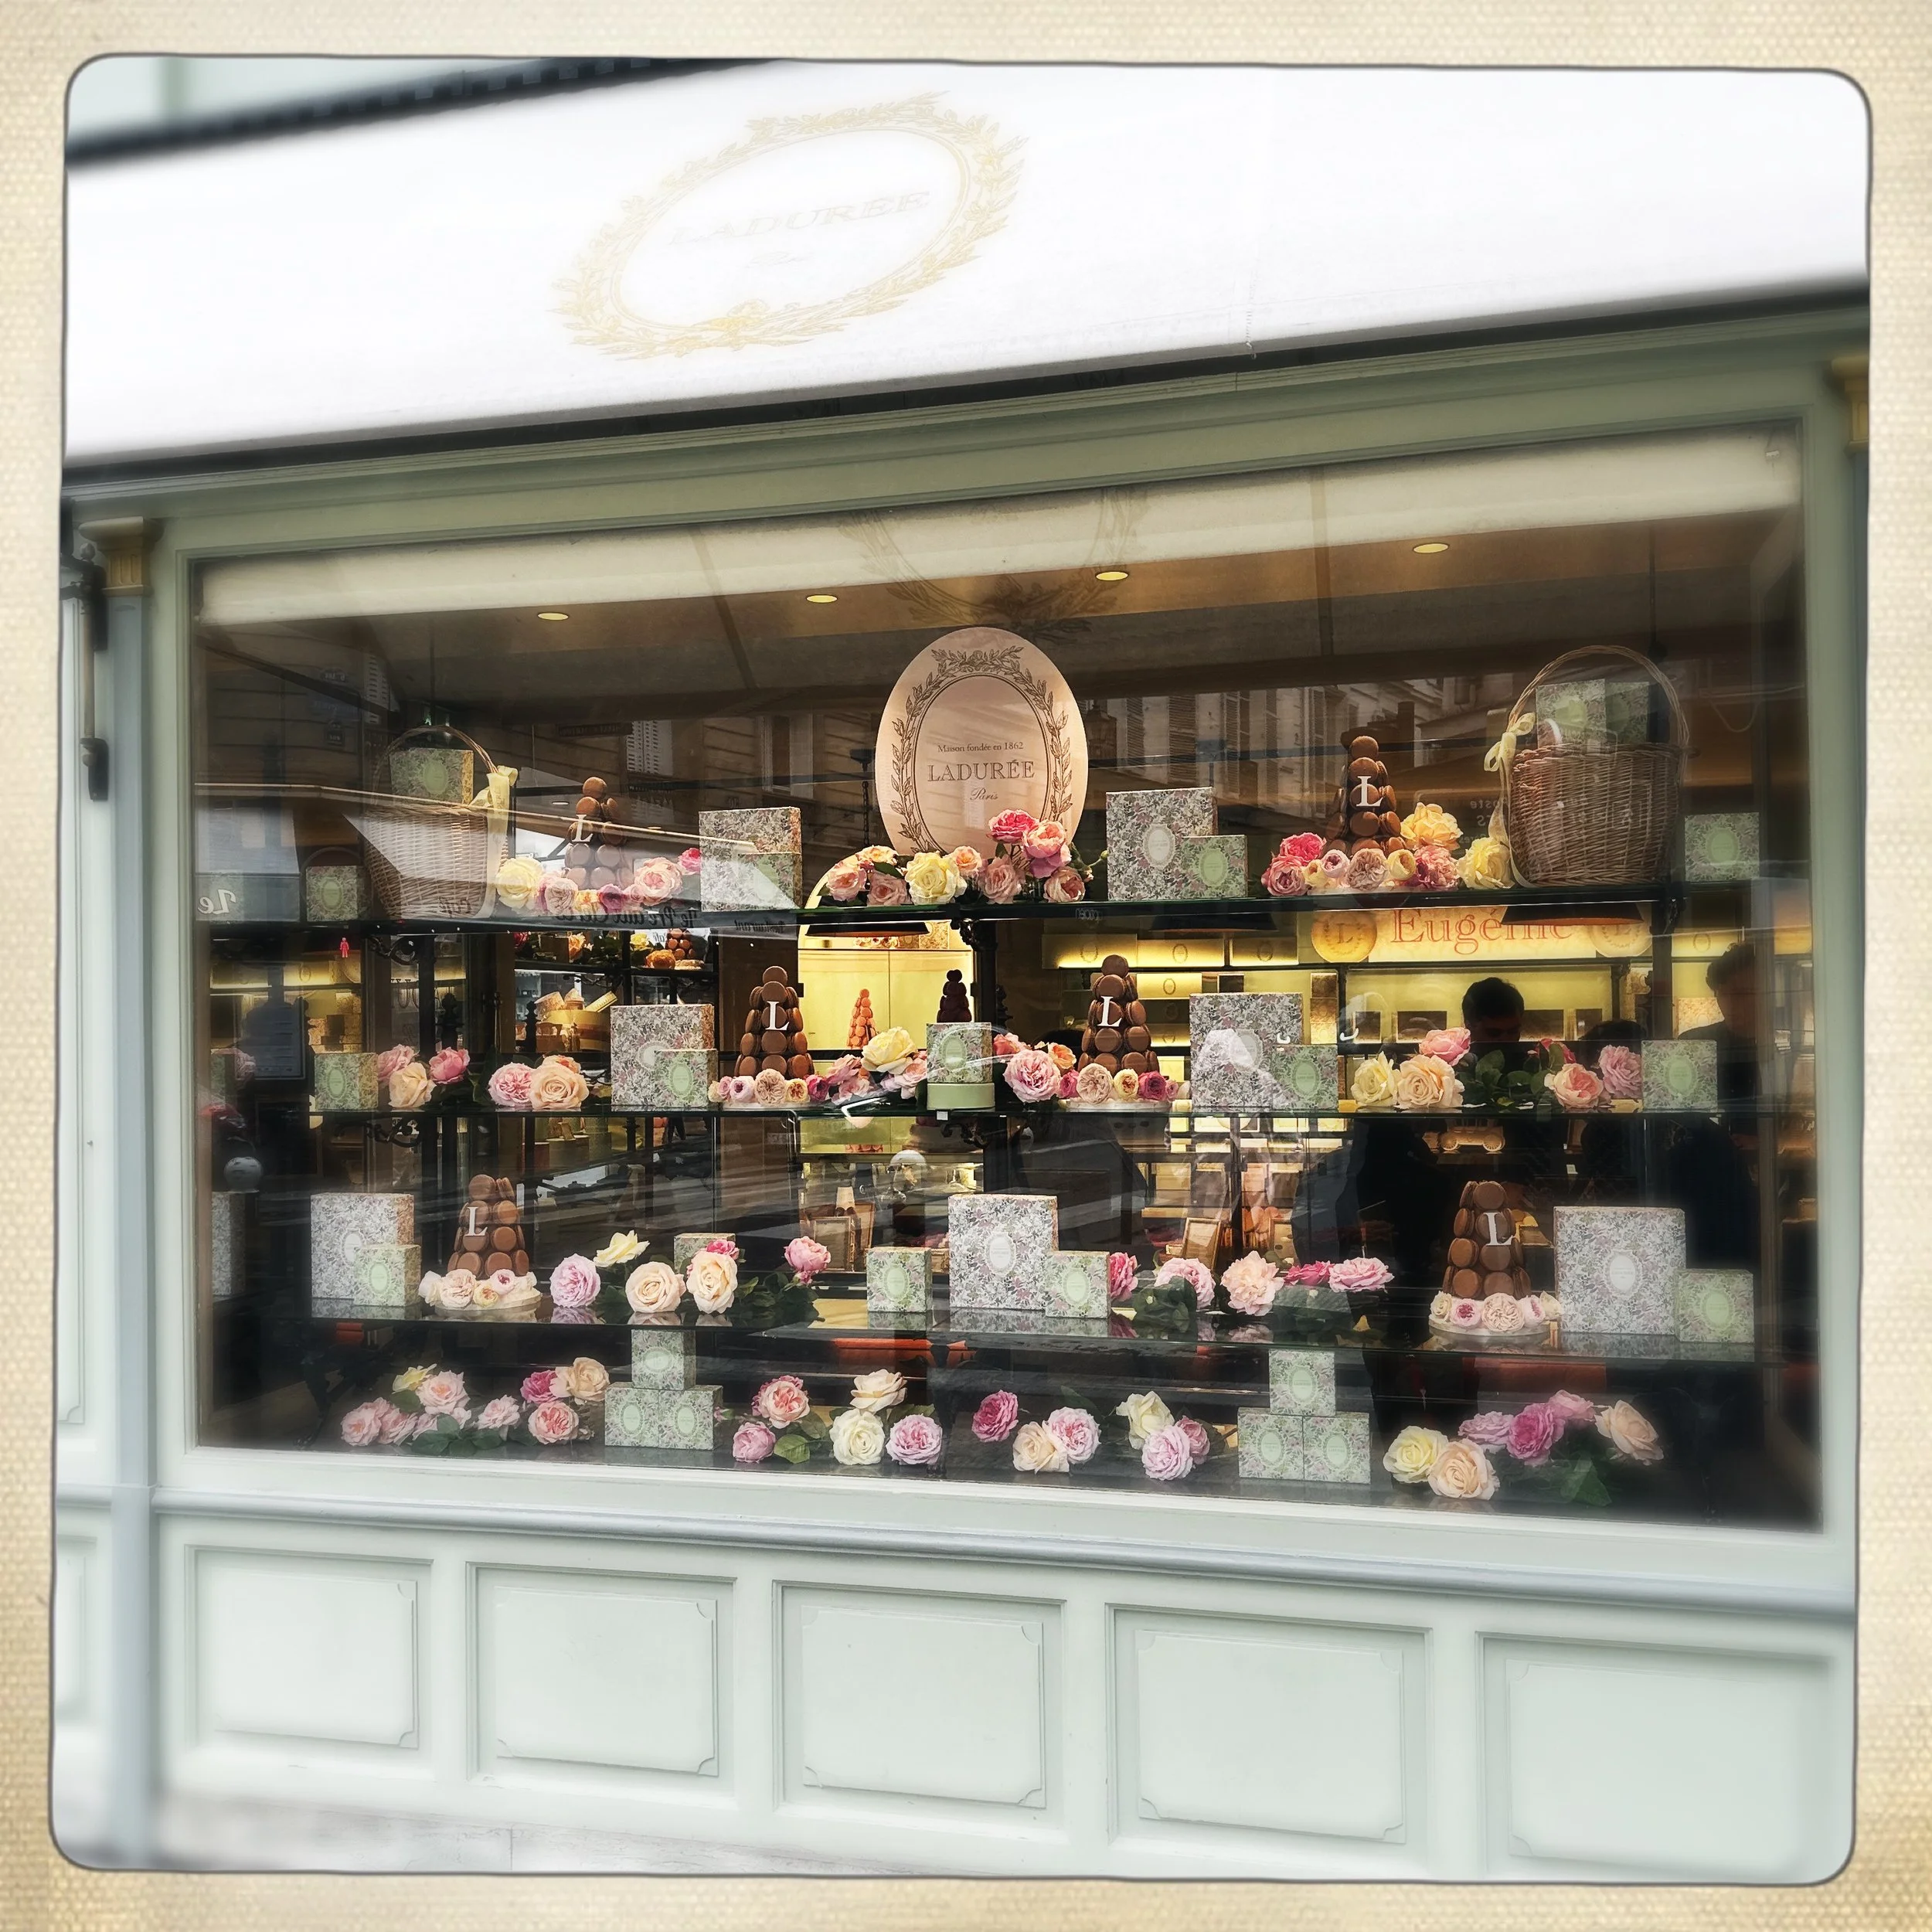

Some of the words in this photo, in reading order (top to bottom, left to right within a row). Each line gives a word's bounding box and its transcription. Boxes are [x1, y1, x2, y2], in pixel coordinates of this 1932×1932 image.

[937, 743, 965, 753] Maison
[966, 742, 992, 752] fondée
[1004, 741, 1024, 750] 1862
[927, 759, 1036, 782] LADURÉE
[969, 787, 998, 801] Paris
[1356, 775, 1383, 808] L
[572, 813, 594, 843] L
[766, 1000, 791, 1032] L
[1097, 995, 1122, 1028] L
[466, 1206, 488, 1236] L
[1484, 1211, 1513, 1246] L
